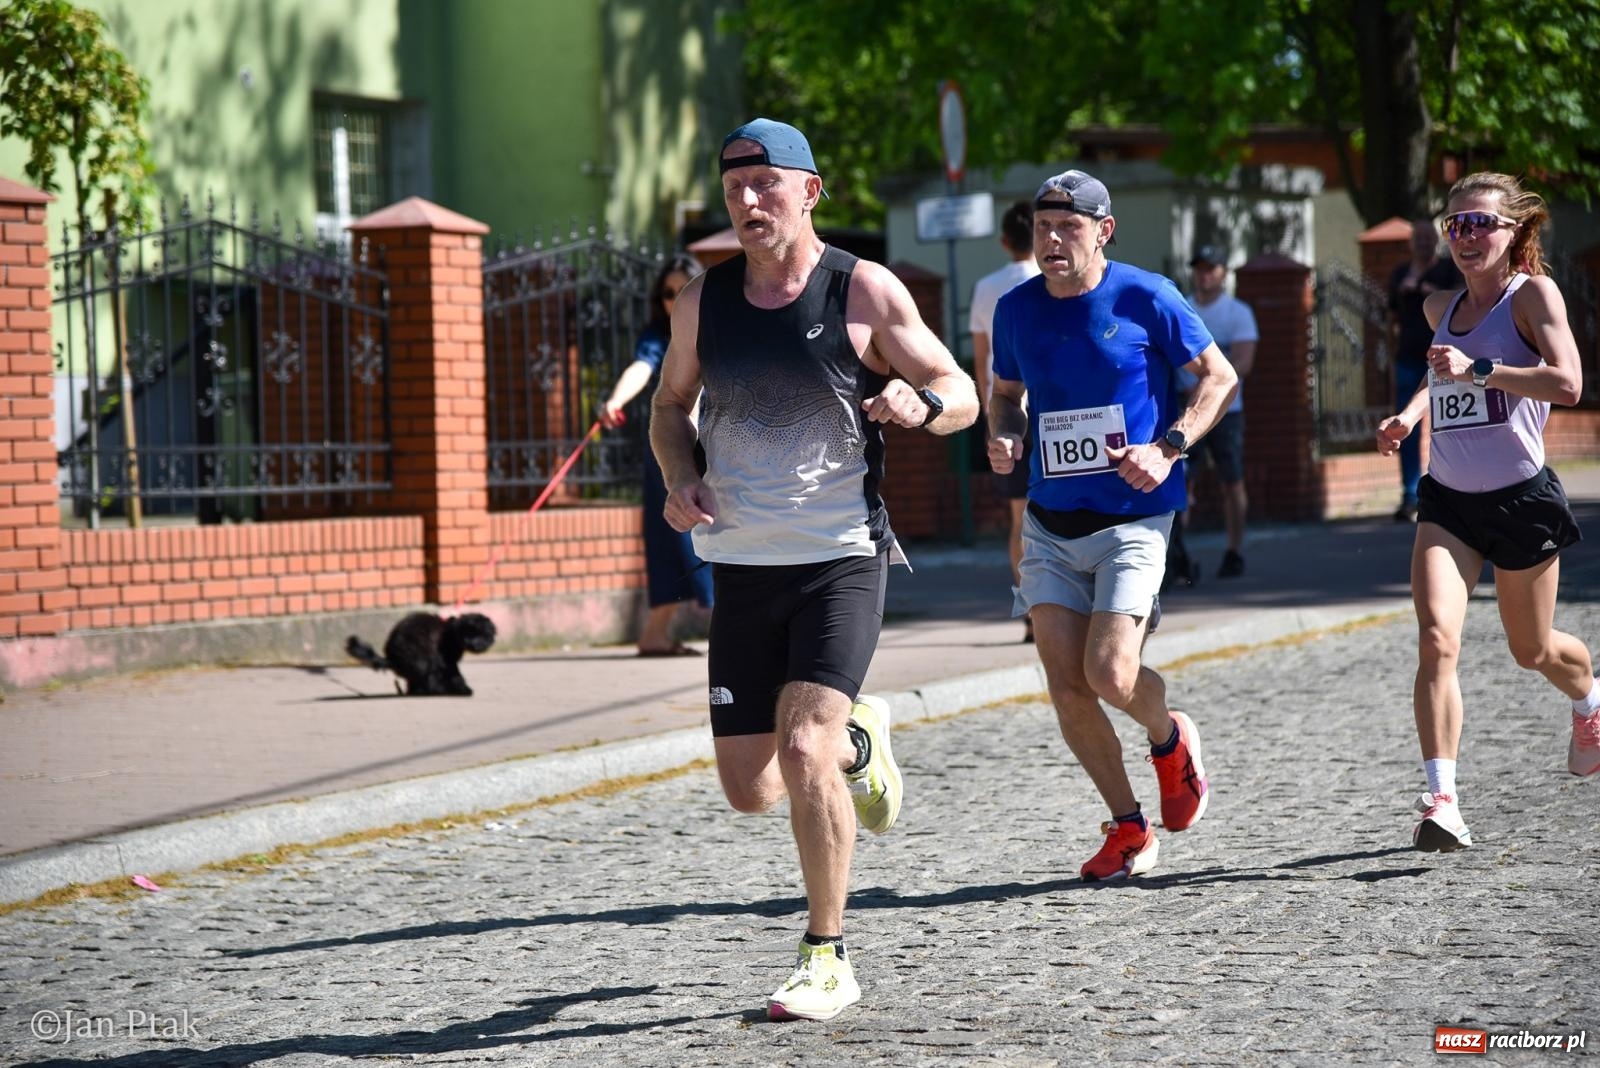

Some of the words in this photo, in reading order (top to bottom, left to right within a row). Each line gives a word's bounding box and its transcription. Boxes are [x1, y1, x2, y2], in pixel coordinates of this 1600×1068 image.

[1438, 392, 1478, 421] 182
[1044, 422, 1074, 433] 3MAJA2026
[1056, 415, 1069, 424] BIEG
[1069, 414, 1080, 423] BEZ
[1080, 411, 1104, 422] GRANIC
[1052, 437, 1099, 465] 180
